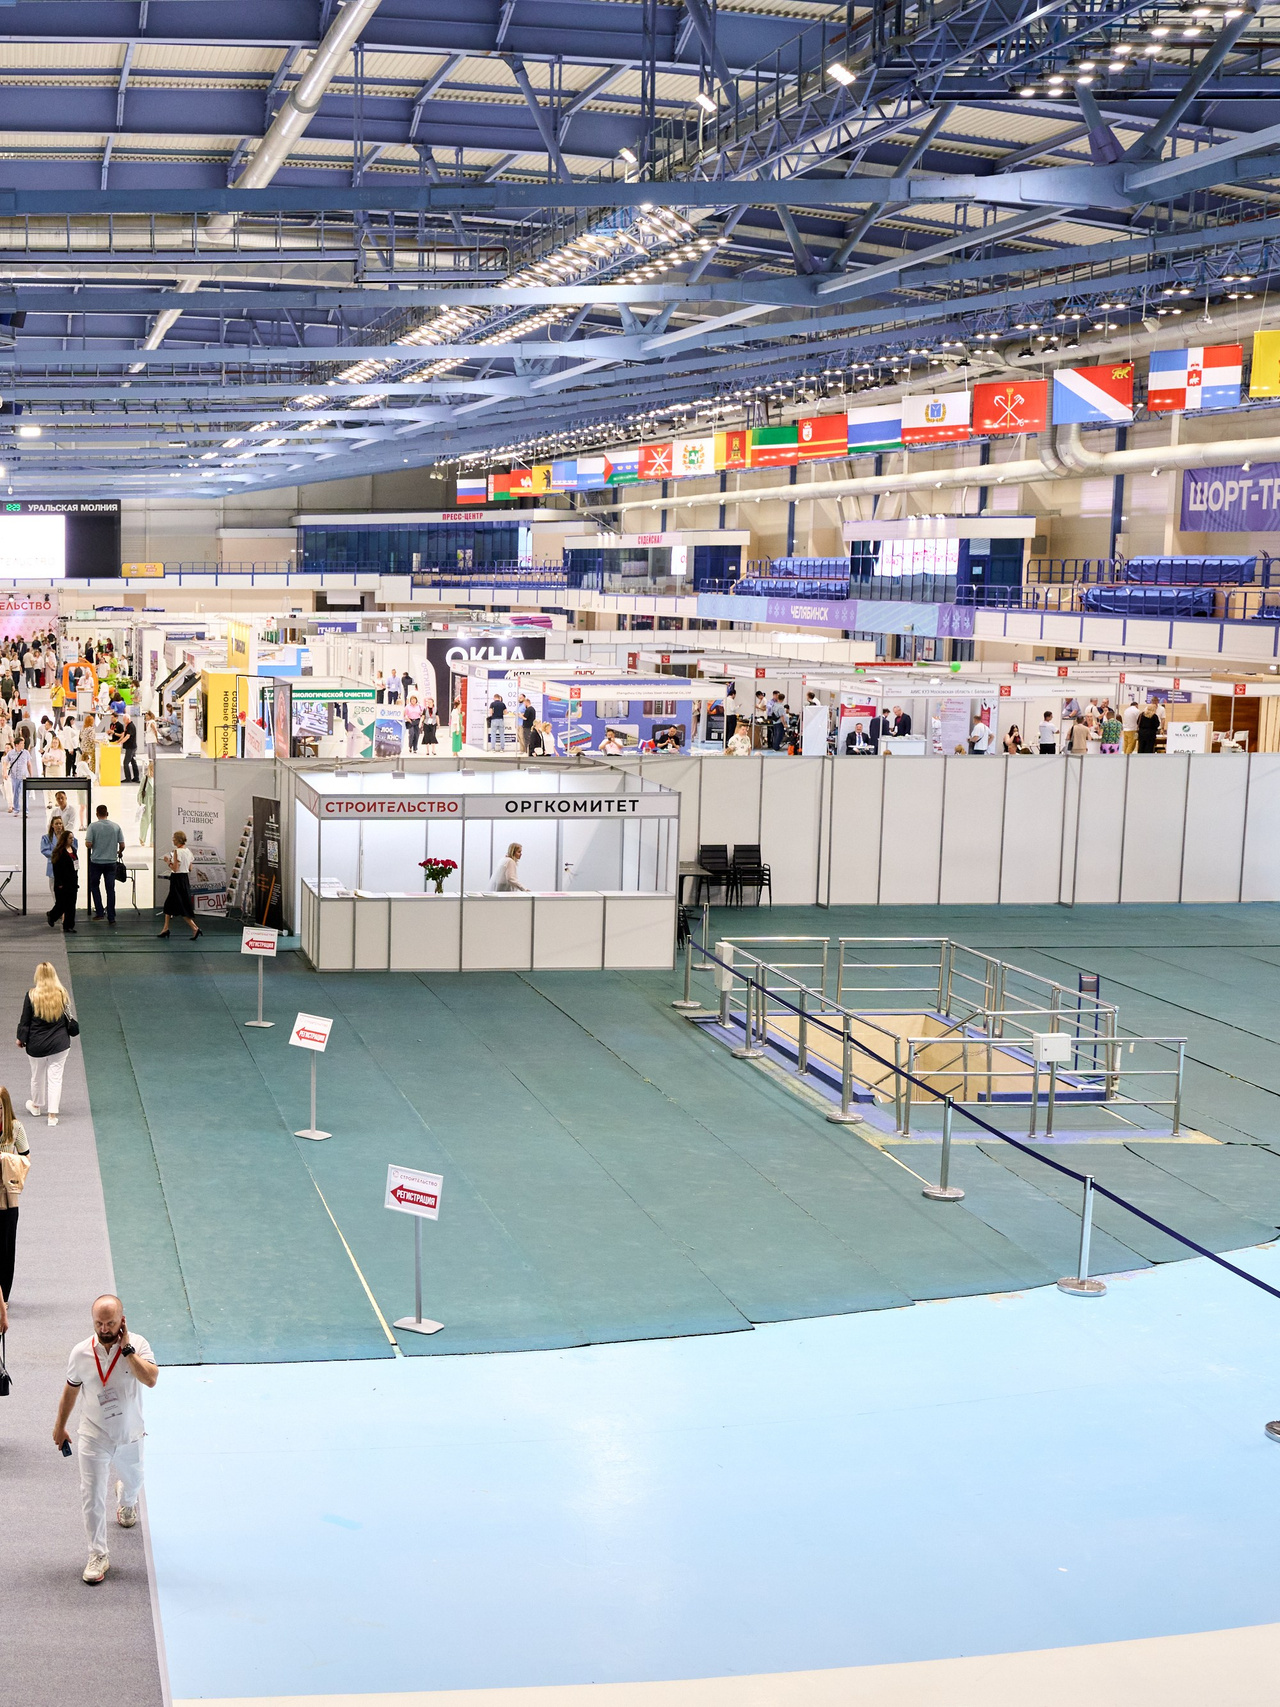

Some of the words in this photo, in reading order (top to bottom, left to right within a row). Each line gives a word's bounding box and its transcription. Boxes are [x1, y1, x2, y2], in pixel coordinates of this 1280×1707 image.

[28, 503, 78, 512] УРАЛЬСКАЯ
[80, 503, 118, 512] МОЛНИЯ
[442, 512, 483, 521] ПРЕСС-ЦЕНТР
[790, 605, 829, 621] ЧЕЛЯБИНСК
[445, 646, 525, 666] ОКНА
[380, 726, 394, 734] ЛОС
[386, 733, 399, 741] КНС
[177, 806, 219, 819] Расскажем
[325, 801, 459, 813] СТРОИТЕЛЬСТВО
[504, 799, 639, 813] ОРГКОМИТЕТ
[400, 1174, 438, 1187] СТРОИТЕЛЬСТВО
[396, 1189, 436, 1206] РЕГИСТРАЦИЯ
